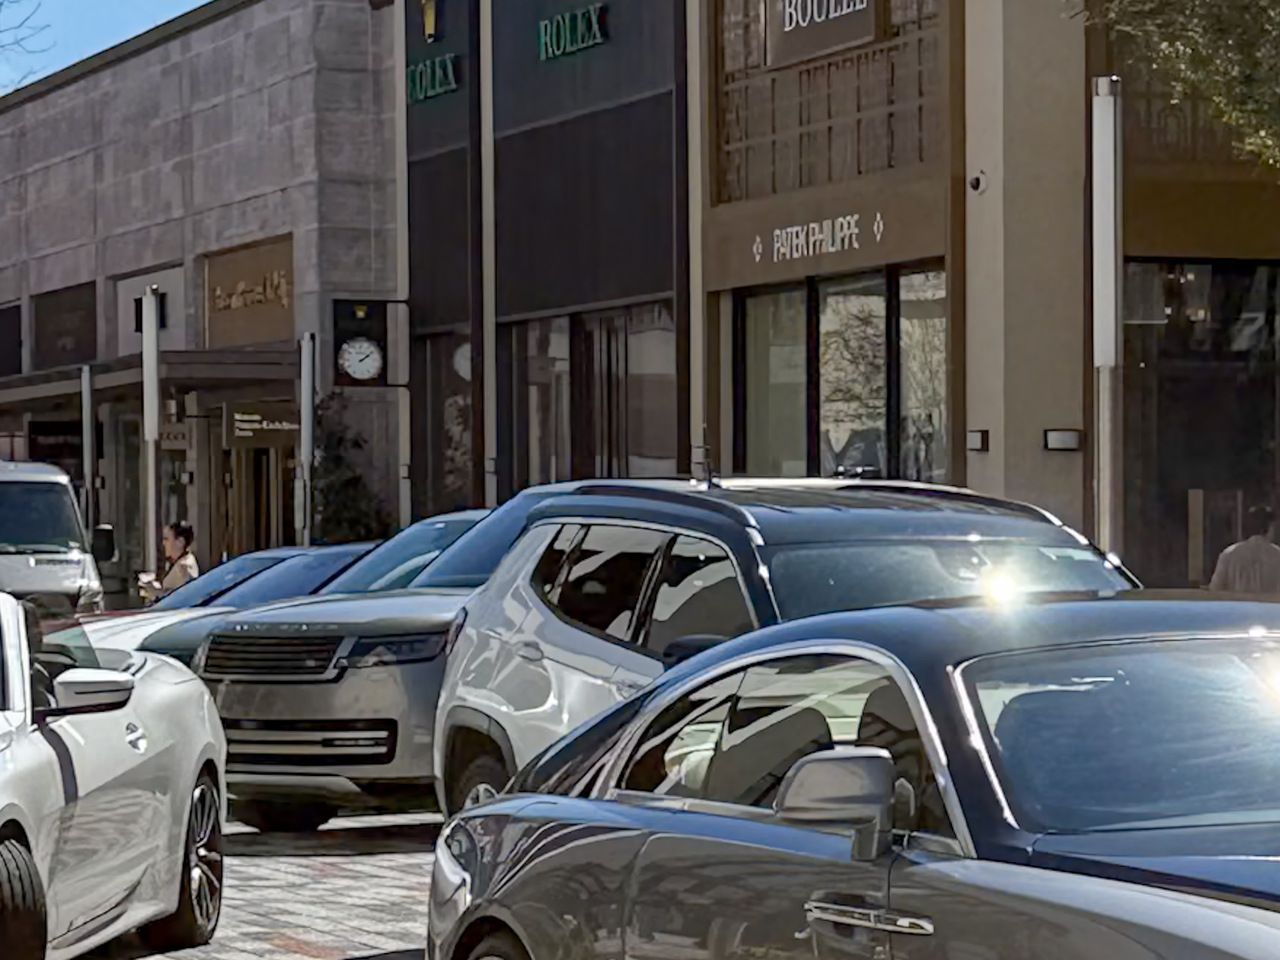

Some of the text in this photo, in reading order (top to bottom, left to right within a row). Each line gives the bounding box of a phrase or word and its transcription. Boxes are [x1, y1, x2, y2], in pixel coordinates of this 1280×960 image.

[539, 2, 604, 60] ROLEX
[783, 0, 868, 31] BOUL
[773, 213, 860, 262] PATEK PHILIPPE
